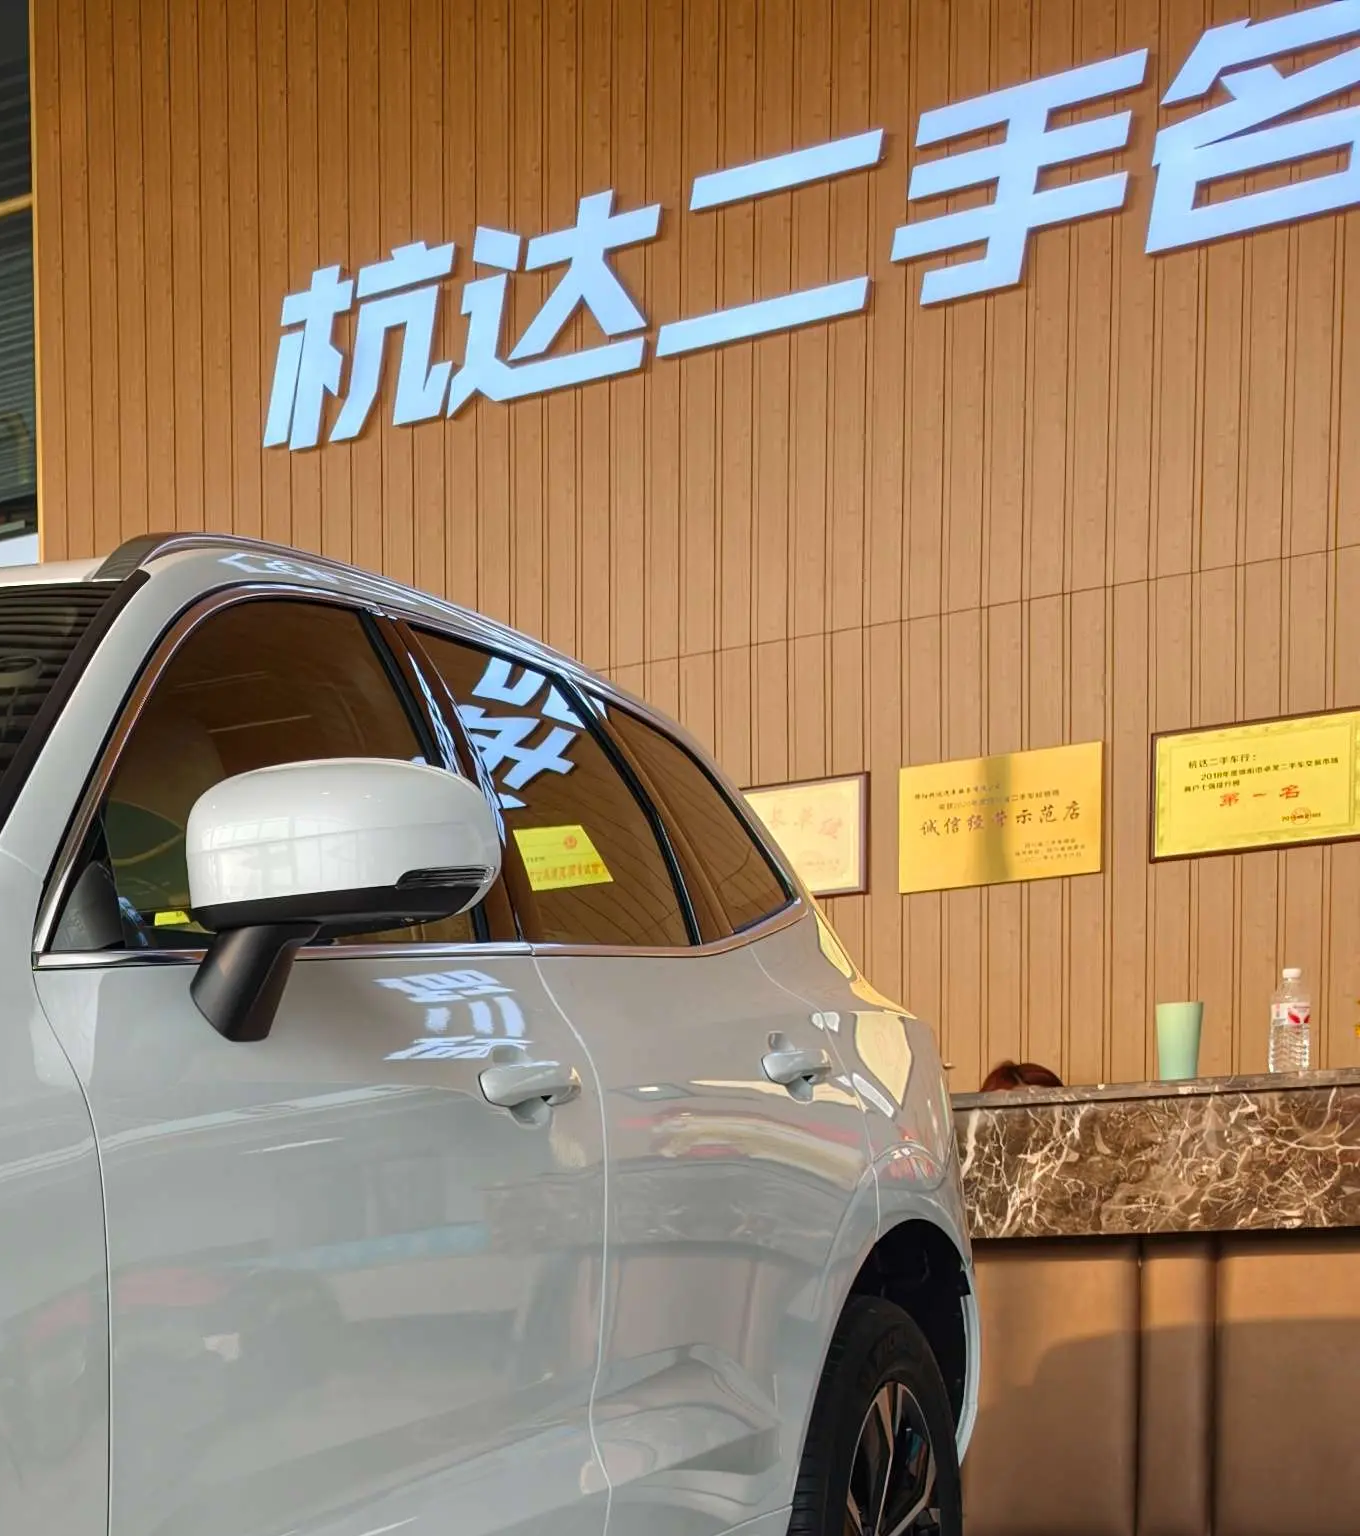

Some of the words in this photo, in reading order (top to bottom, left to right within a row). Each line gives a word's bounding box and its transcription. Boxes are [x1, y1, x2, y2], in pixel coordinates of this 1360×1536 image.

[263, 0, 1360, 450] 杭达二手名
[919, 800, 1081, 836] 诚信经营示范店
